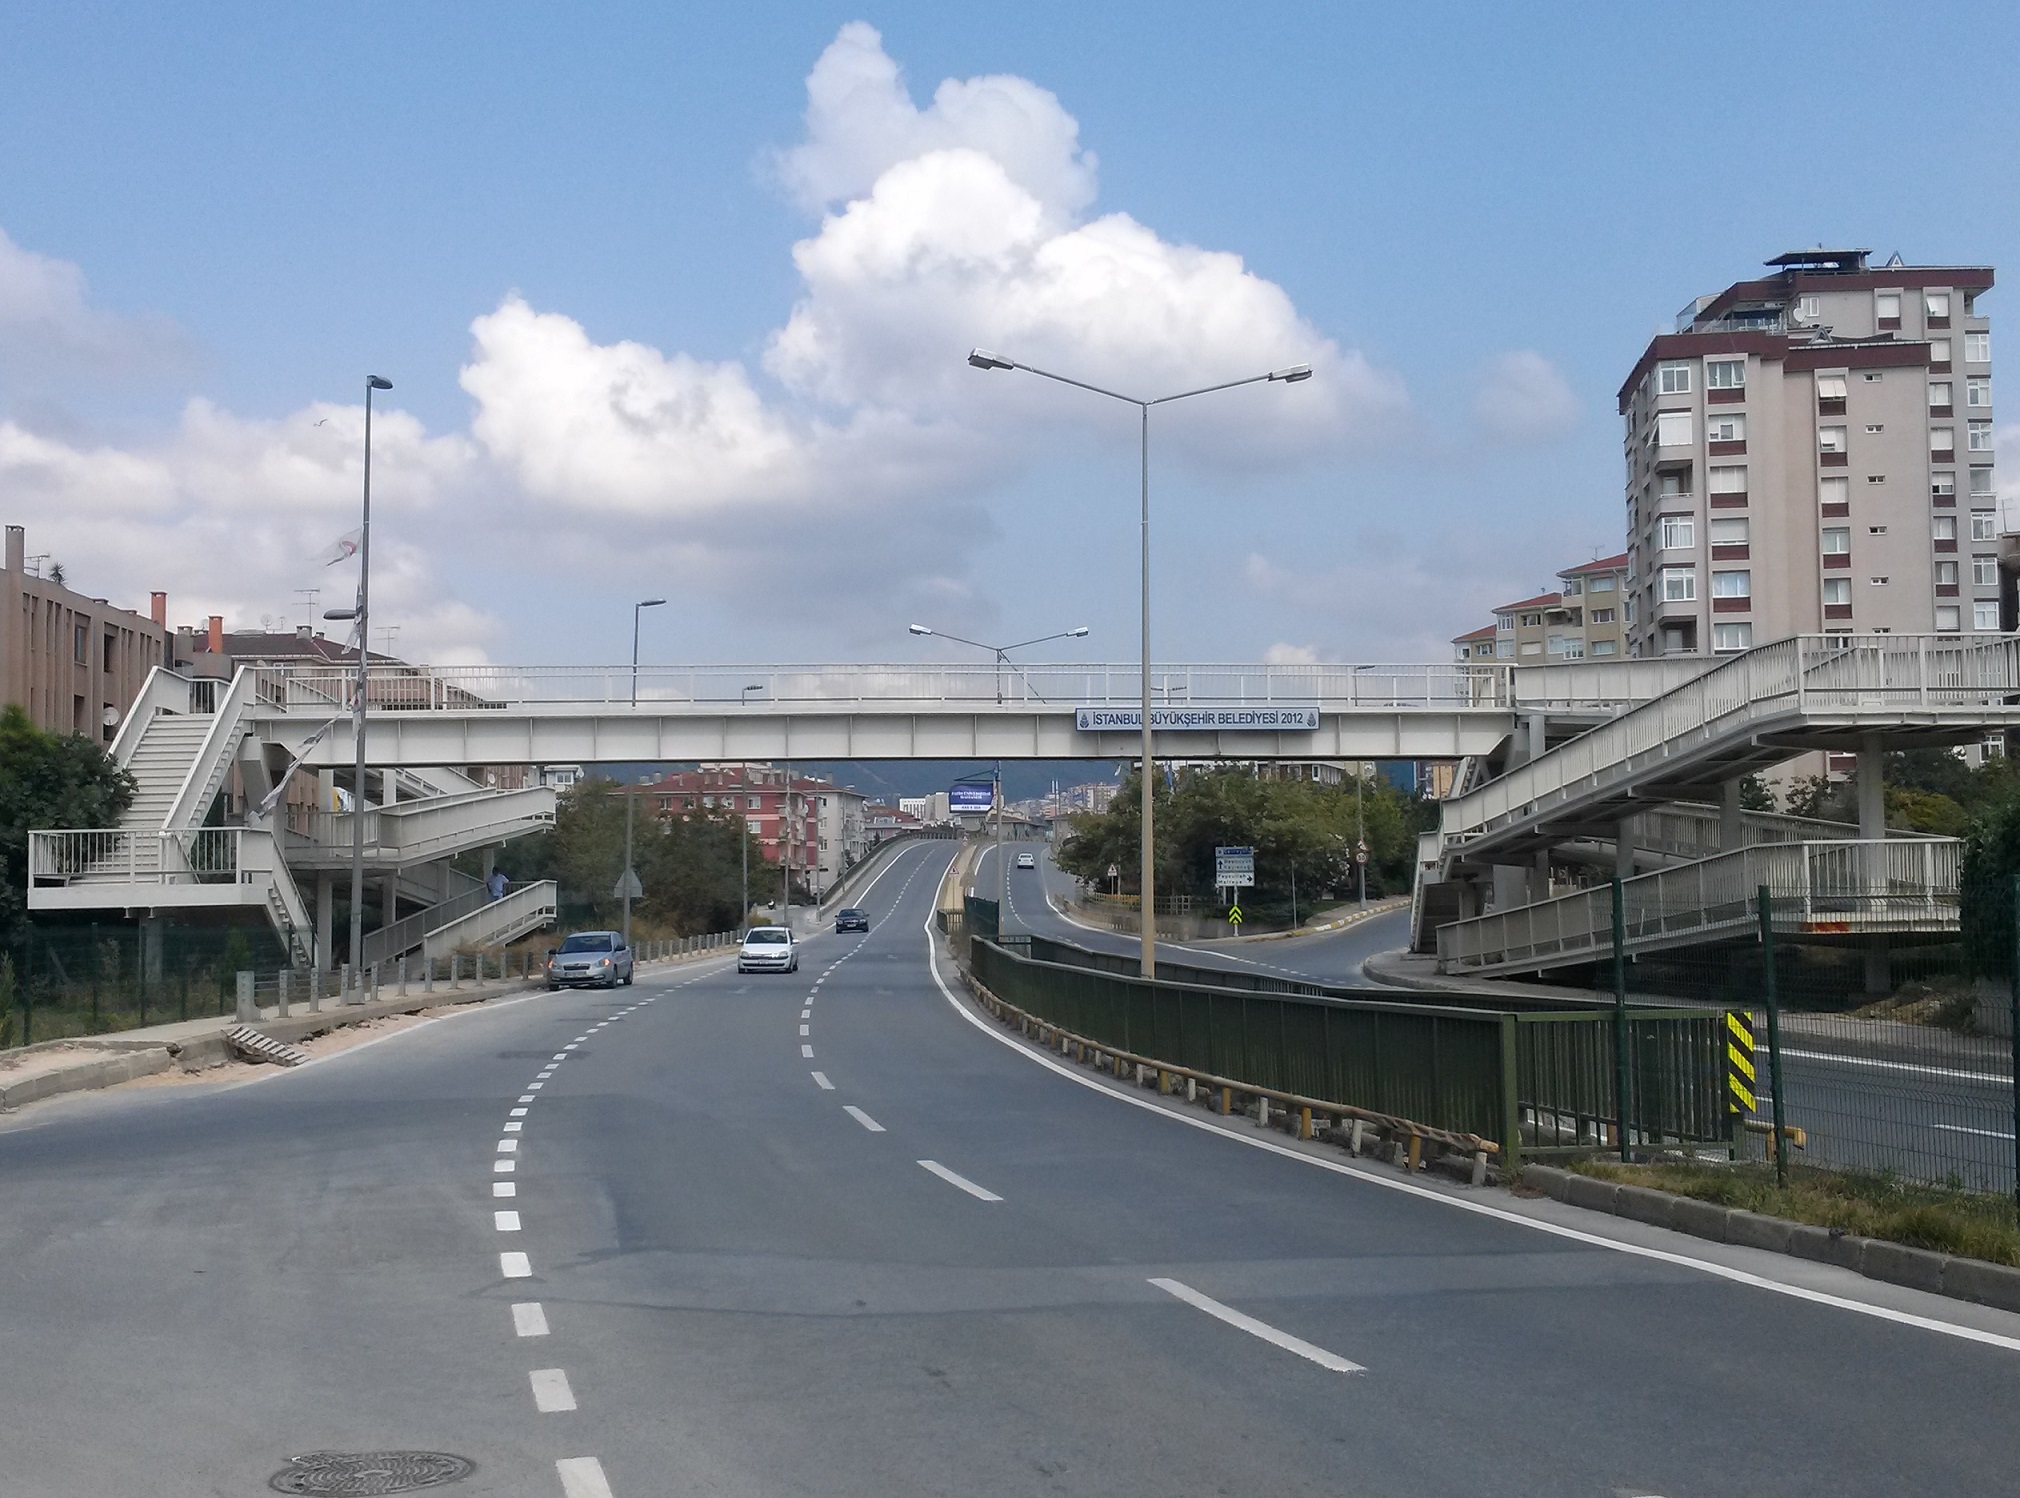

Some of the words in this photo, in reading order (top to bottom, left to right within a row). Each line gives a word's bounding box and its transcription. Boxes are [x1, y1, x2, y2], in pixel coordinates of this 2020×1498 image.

[1093, 711, 1143, 725] İSTANBUL
[1150, 711, 1214, 728] BÜYÜKŞEHİR
[1218, 710, 1278, 725] BELEDİYESİ
[1281, 712, 1303, 725] 2012
